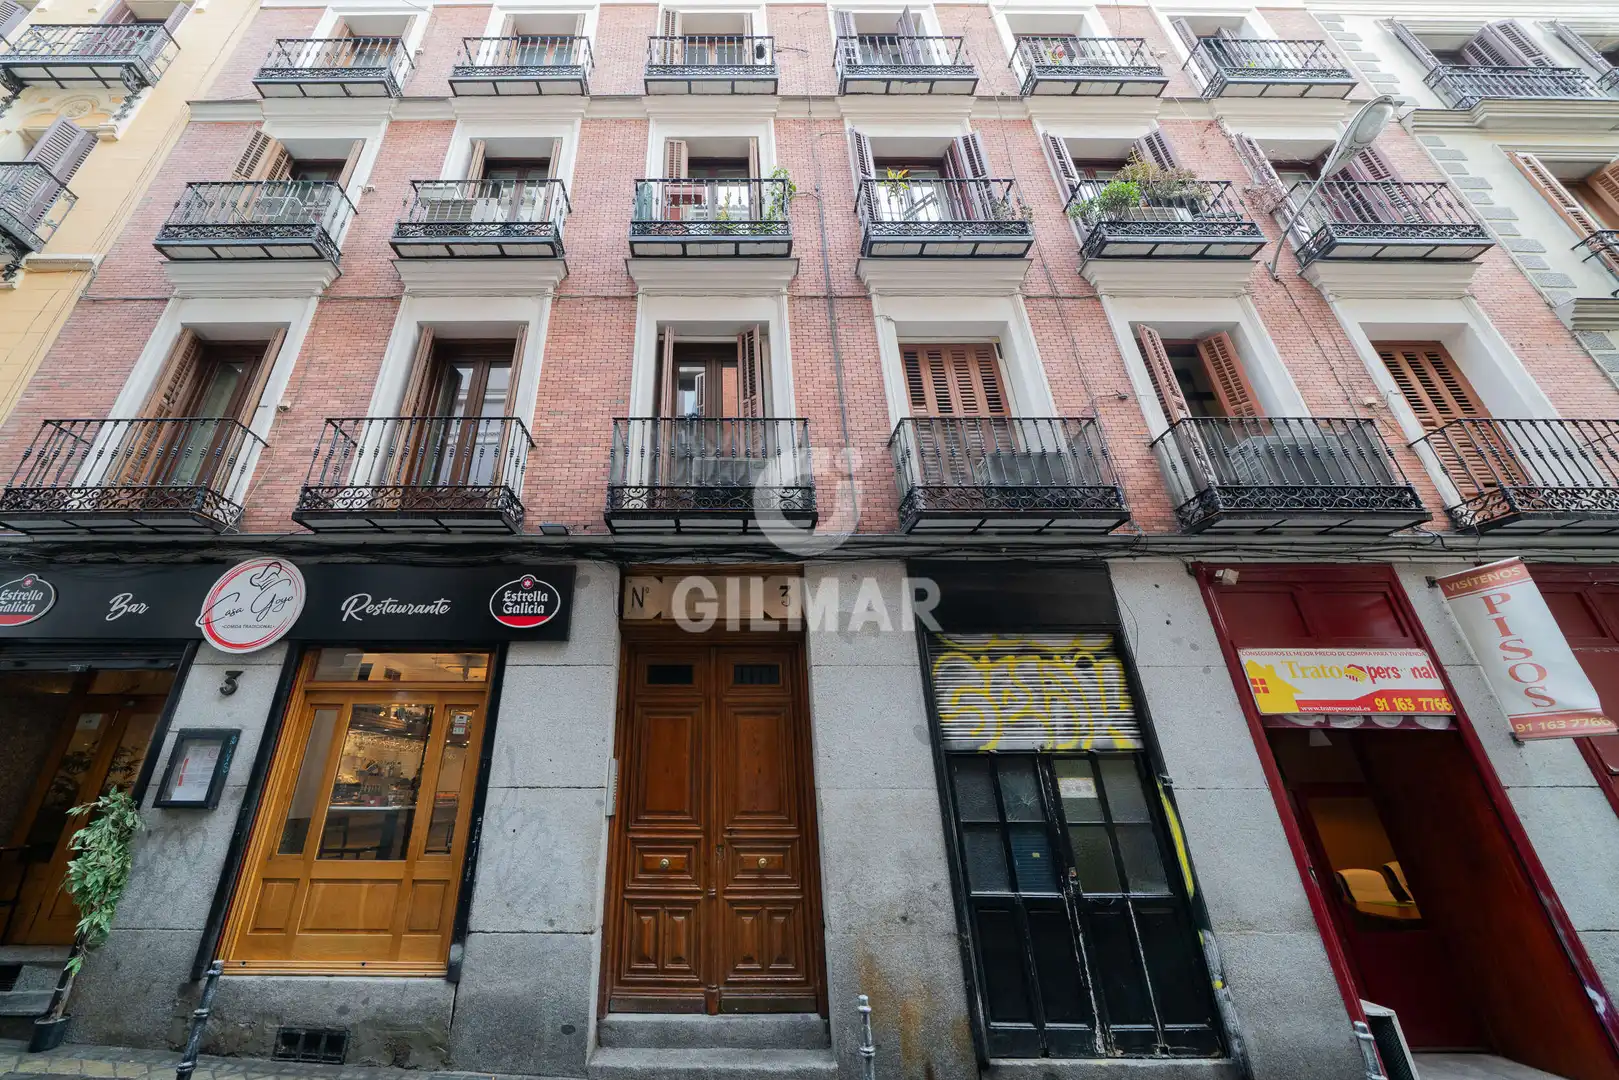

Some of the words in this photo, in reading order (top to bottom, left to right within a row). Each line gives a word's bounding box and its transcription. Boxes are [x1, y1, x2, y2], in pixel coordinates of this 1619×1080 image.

[1446, 567, 1522, 592] VISÍTENOS
[0, 589, 44, 601] Estrella
[105, 592, 150, 621] Bar
[198, 591, 244, 626] Casa
[250, 578, 294, 622] Goyo
[340, 593, 451, 621] Restaurante
[502, 590, 548, 602] Estrella
[502, 602, 545, 614] Galicia
[1480, 592, 1557, 708] PISOS
[219, 670, 244, 696] 3
[1280, 660, 1343, 679] Trato
[1366, 659, 1438, 685] persnal
[1374, 697, 1390, 711] 91
[1393, 697, 1416, 711] 163
[1417, 697, 1454, 712] 7766
[1516, 723, 1533, 733] 91
[1539, 720, 1566, 730] 163
[1570, 717, 1613, 729] 7766
